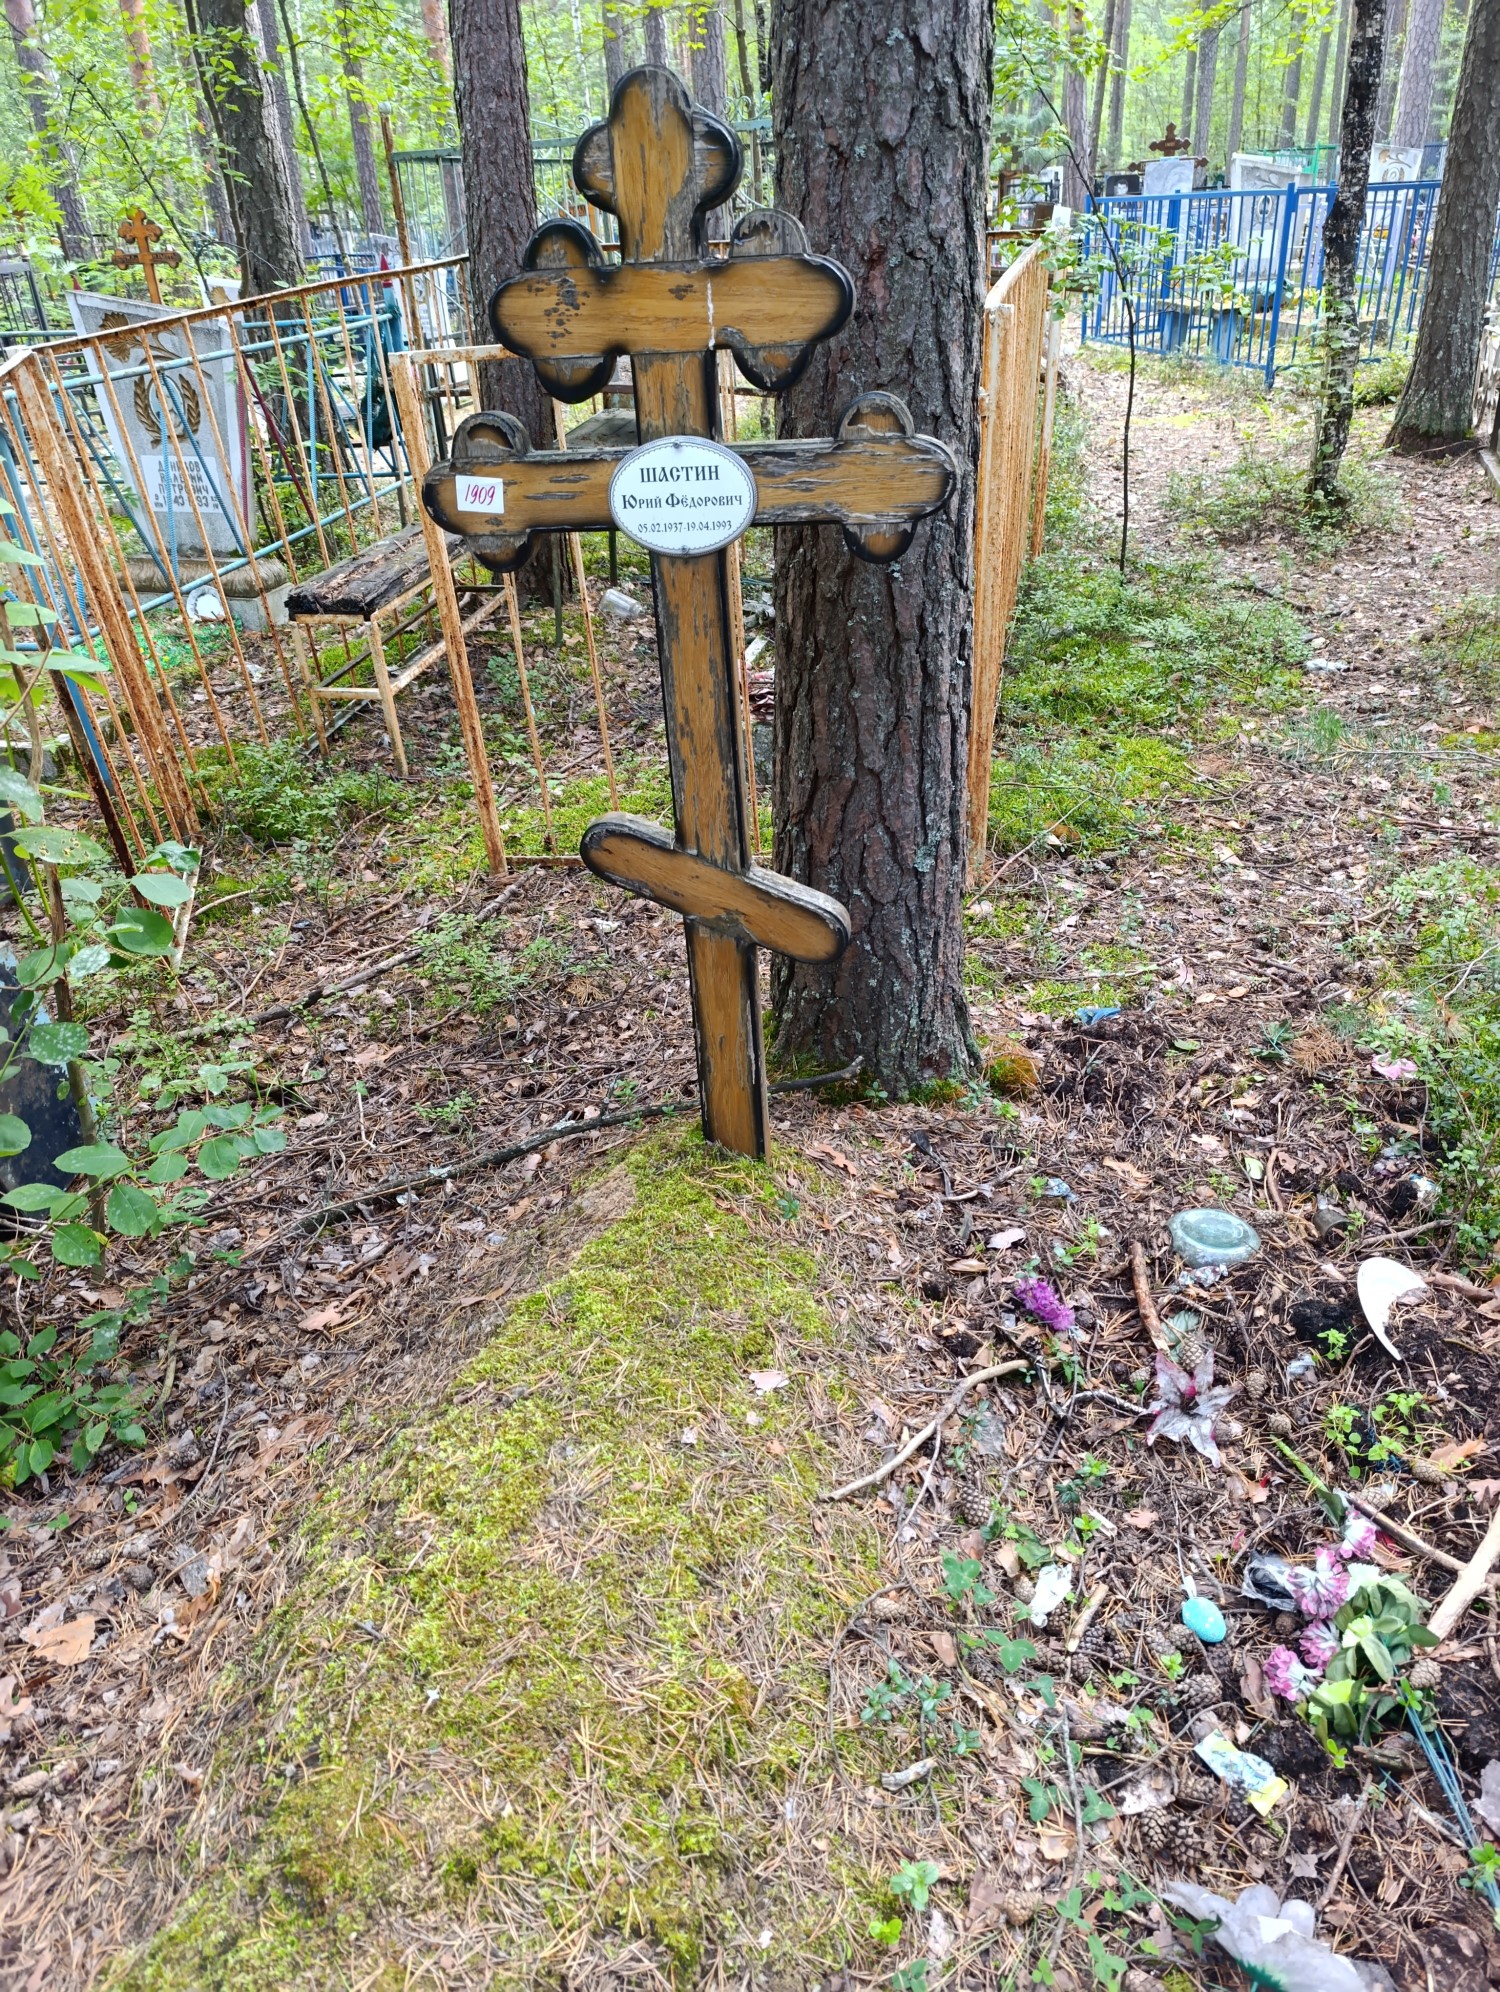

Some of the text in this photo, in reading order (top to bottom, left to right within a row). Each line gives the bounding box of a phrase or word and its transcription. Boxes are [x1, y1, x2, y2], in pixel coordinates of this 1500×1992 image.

[639, 465, 720, 483] ШАСТИН
[465, 483, 496, 506] 1909
[621, 494, 662, 509] Юрий
